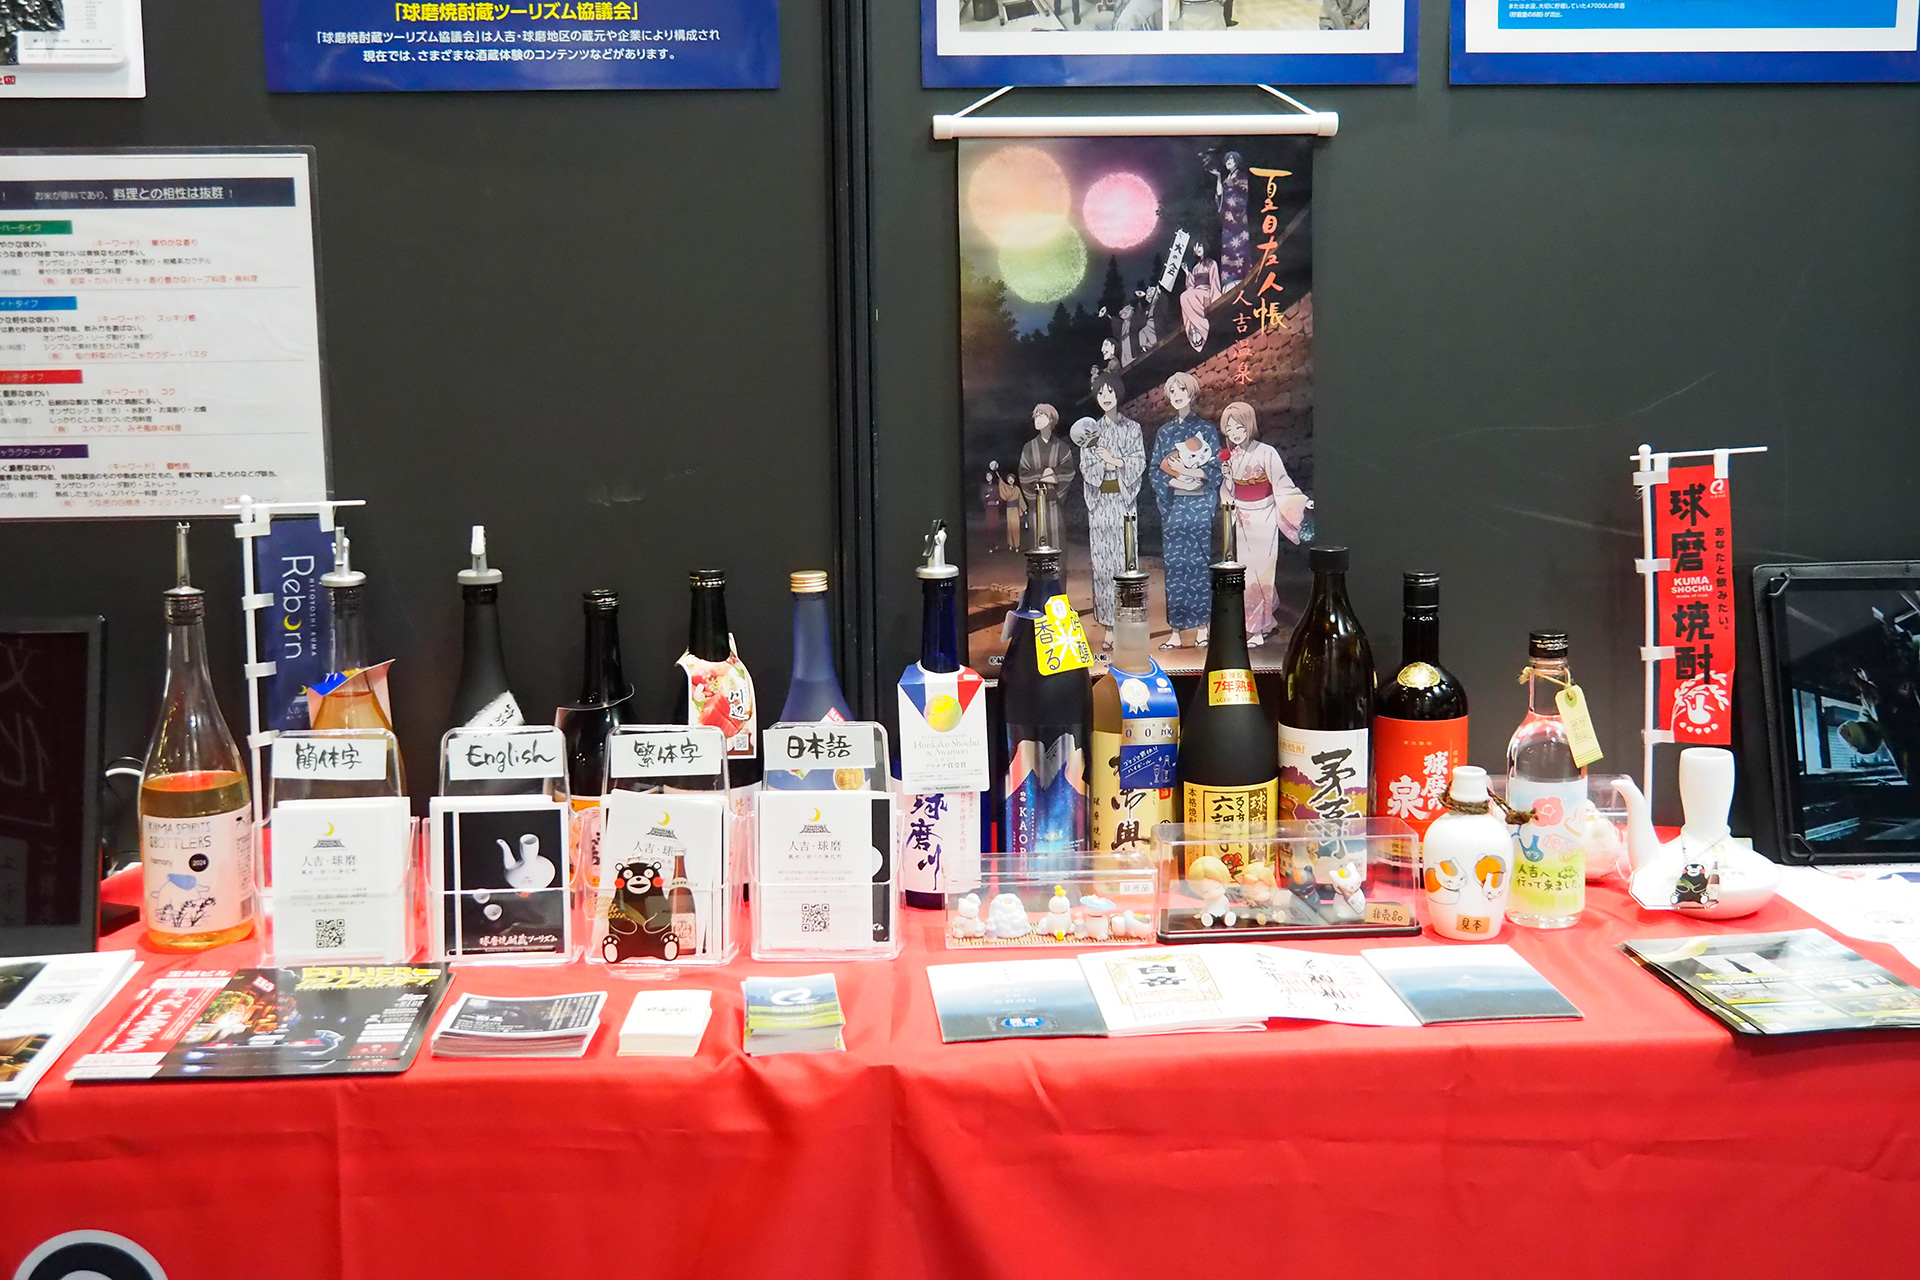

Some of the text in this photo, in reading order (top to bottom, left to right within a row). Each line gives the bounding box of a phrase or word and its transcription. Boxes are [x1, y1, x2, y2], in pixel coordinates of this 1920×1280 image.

[395, 2, 638, 21] 「球磨焼酎蔵ツーリズム協議会」
[363, 48, 675, 63] 現在では、さまざまな酒蔵体験のコンテンツなどがあります。
[1232, 290, 1253, 384] 人吉温泉
[1670, 585, 1714, 594] SHOCHU
[1673, 576, 1710, 586] KUMA
[1714, 527, 1730, 631] あなたと飲みたい。
[1034, 619, 1061, 671] 香る
[465, 739, 557, 773] English
[786, 731, 852, 760] 日本語
[1421, 750, 1449, 811] 球磨の
[1387, 775, 1431, 820] 泉
[633, 840, 675, 858] 人吉・球
[1517, 864, 1551, 879] 人吉へ
[1461, 919, 1482, 932] 見本
